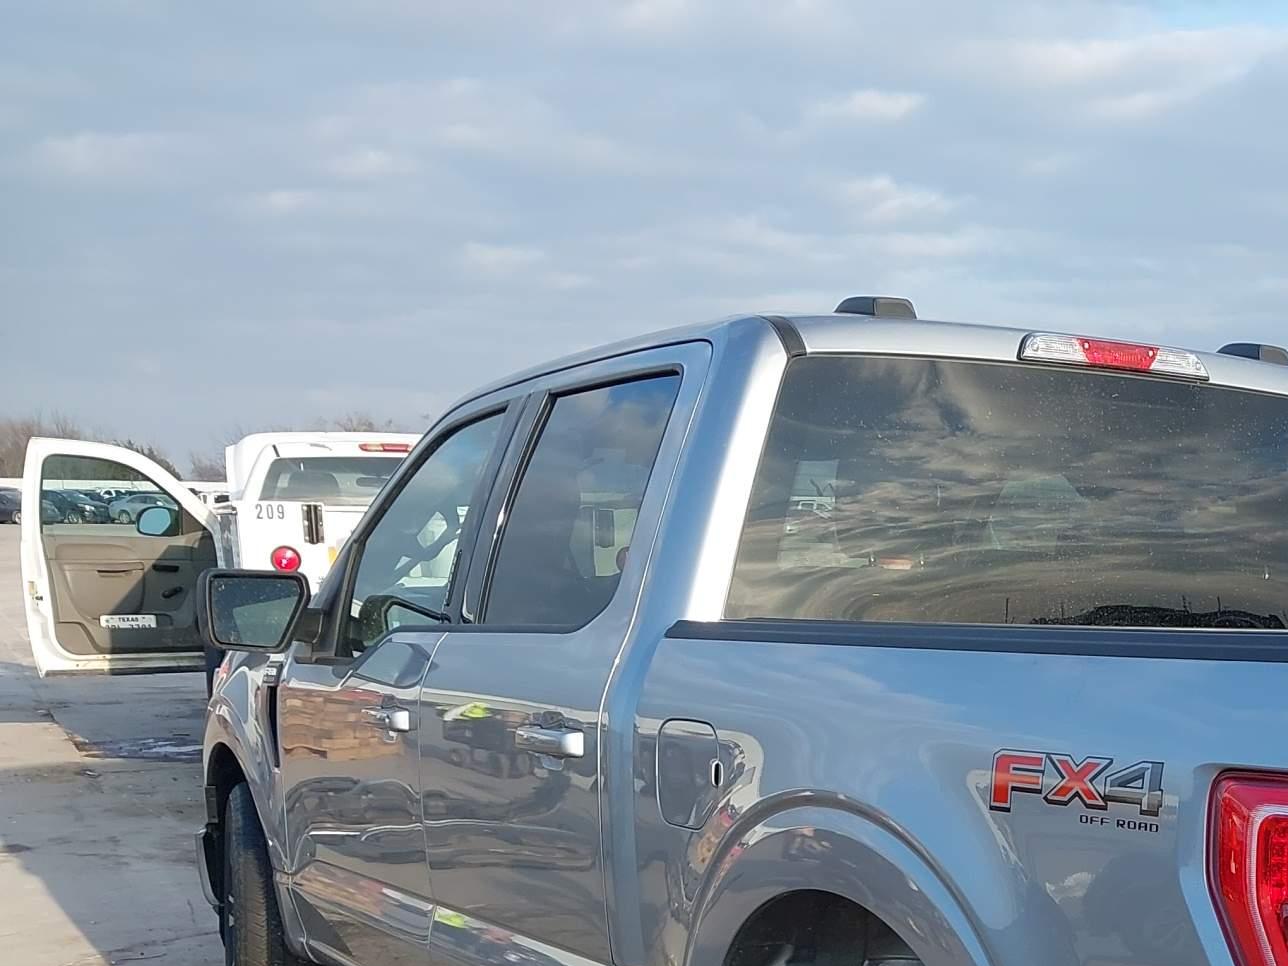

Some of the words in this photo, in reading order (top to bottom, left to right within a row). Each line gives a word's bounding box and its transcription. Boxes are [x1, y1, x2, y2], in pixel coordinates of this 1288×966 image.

[255, 503, 285, 520] 209
[989, 748, 1165, 817] FX4
[1079, 813, 1110, 826] OFF
[1116, 818, 1159, 833] ROAD
